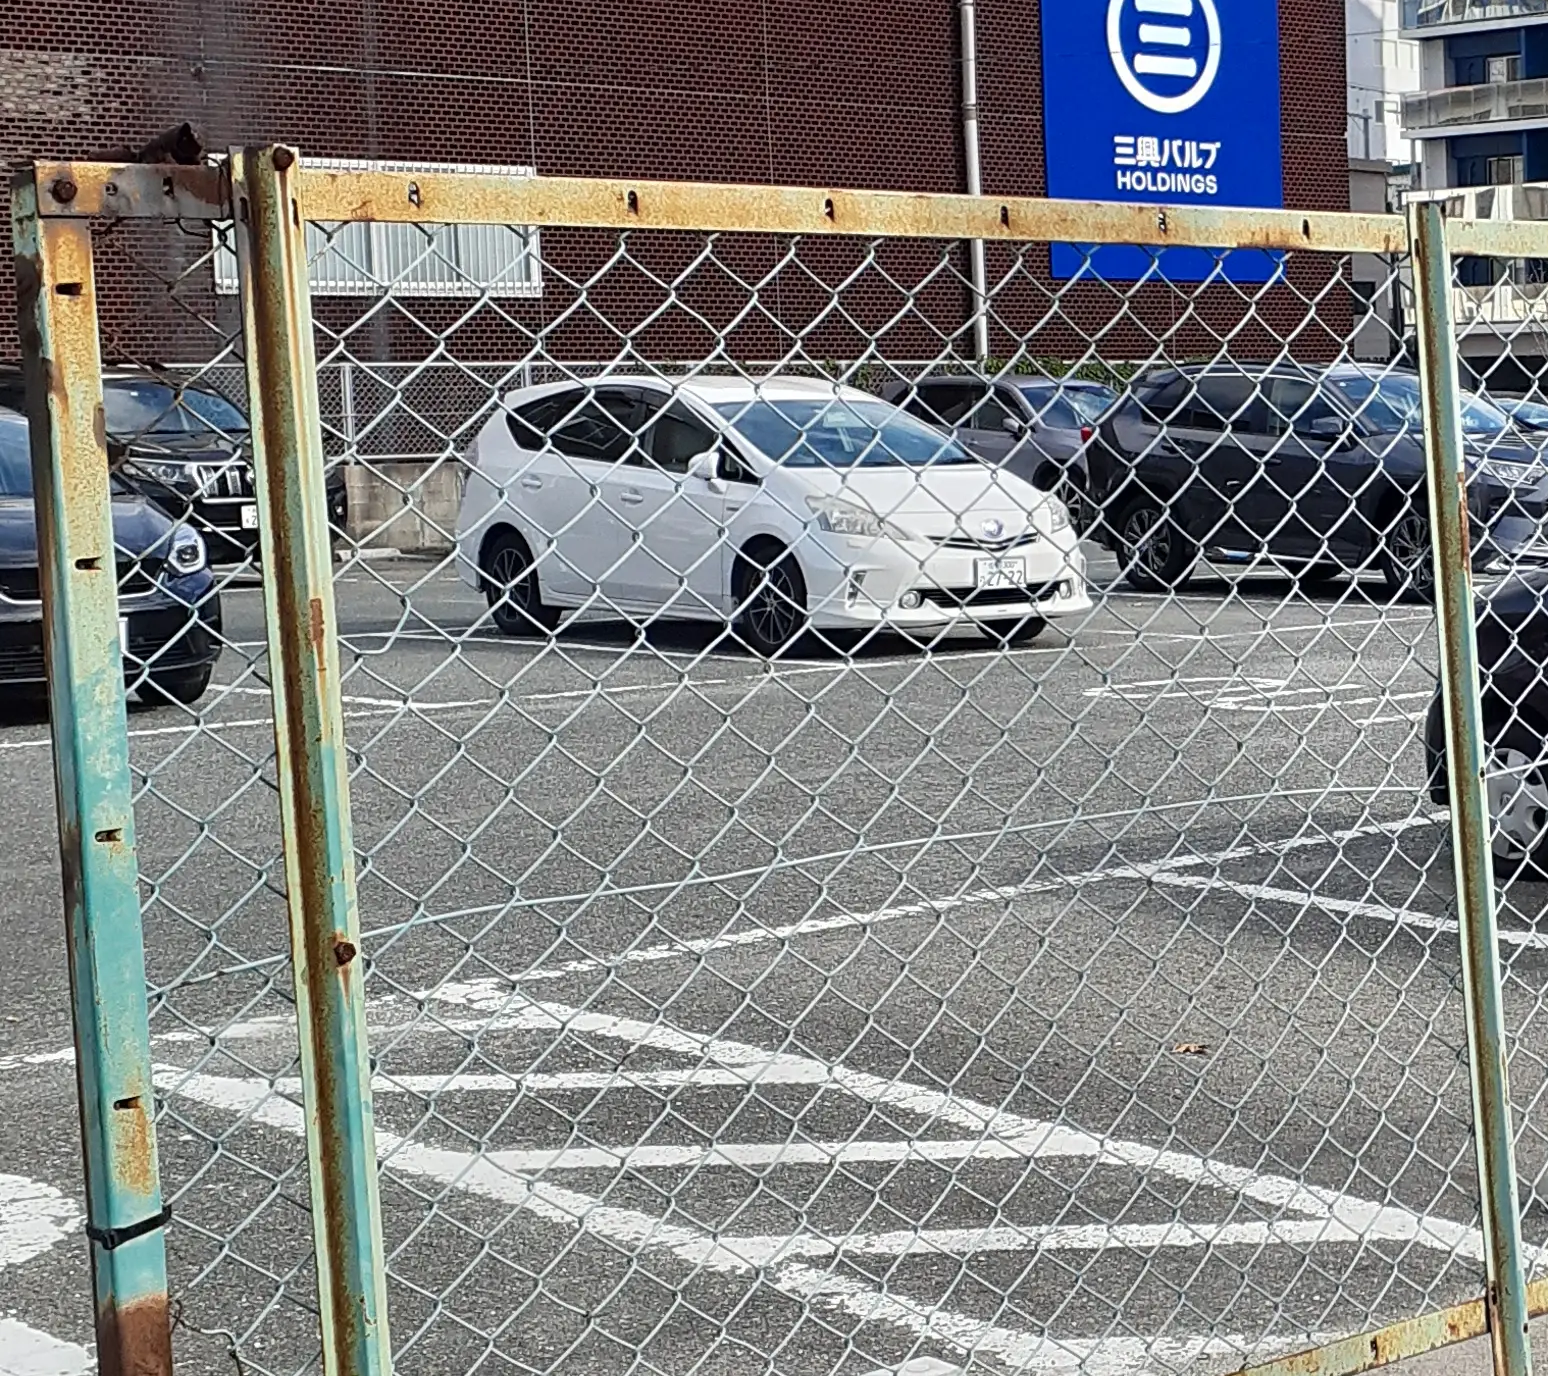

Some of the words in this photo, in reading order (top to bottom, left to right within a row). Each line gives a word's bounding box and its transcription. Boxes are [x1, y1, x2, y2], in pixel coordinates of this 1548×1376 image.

[1114, 135, 1221, 169] 三興バルブ
[1117, 170, 1218, 195] HOLDINGS
